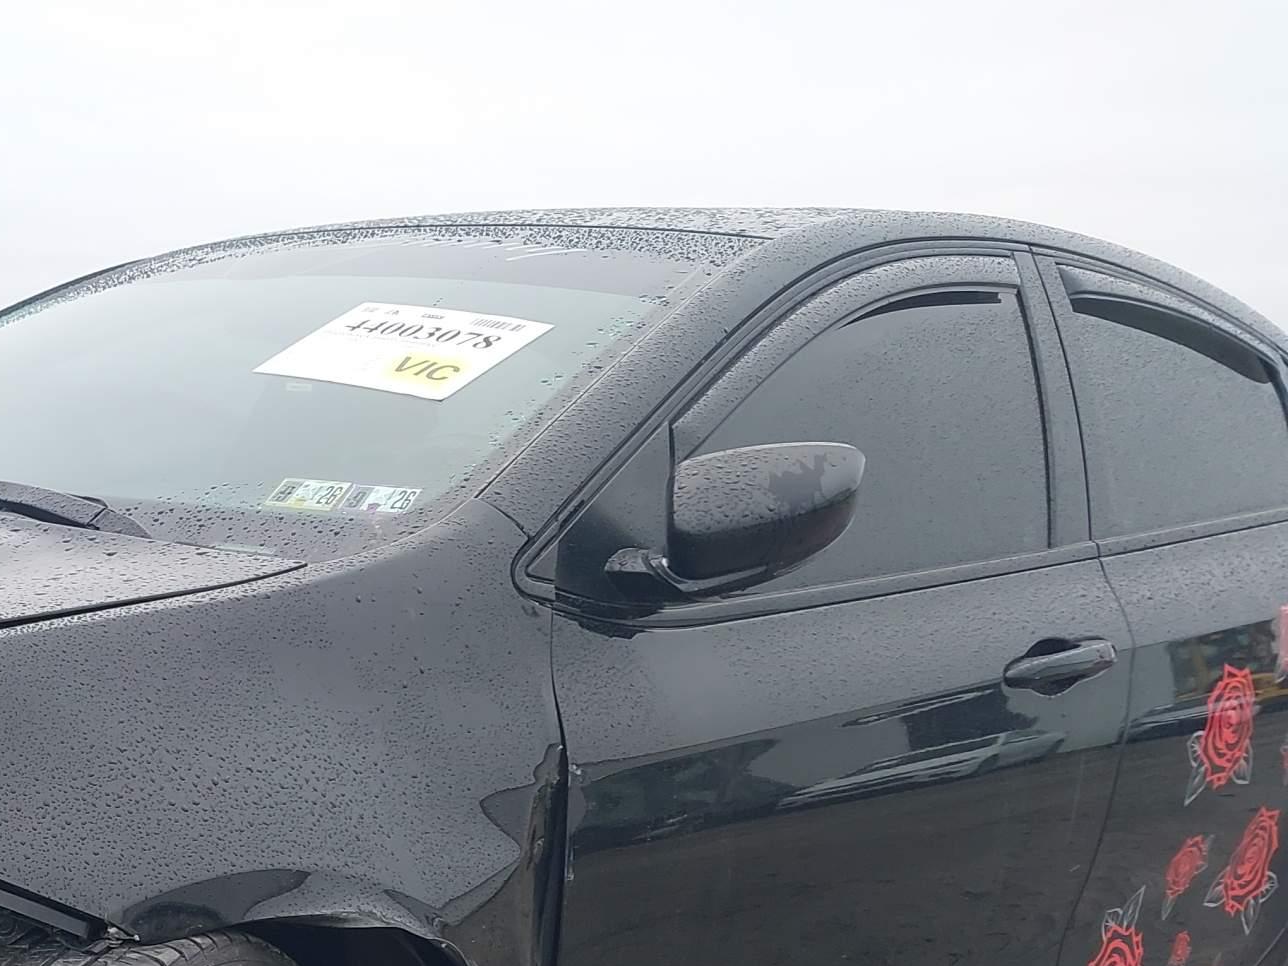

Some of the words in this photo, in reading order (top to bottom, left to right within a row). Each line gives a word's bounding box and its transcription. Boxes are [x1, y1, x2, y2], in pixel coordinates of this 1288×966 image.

[344, 318, 503, 350] 44003078
[394, 356, 461, 381] VIC
[315, 485, 344, 505] 26
[390, 490, 417, 510] 26
